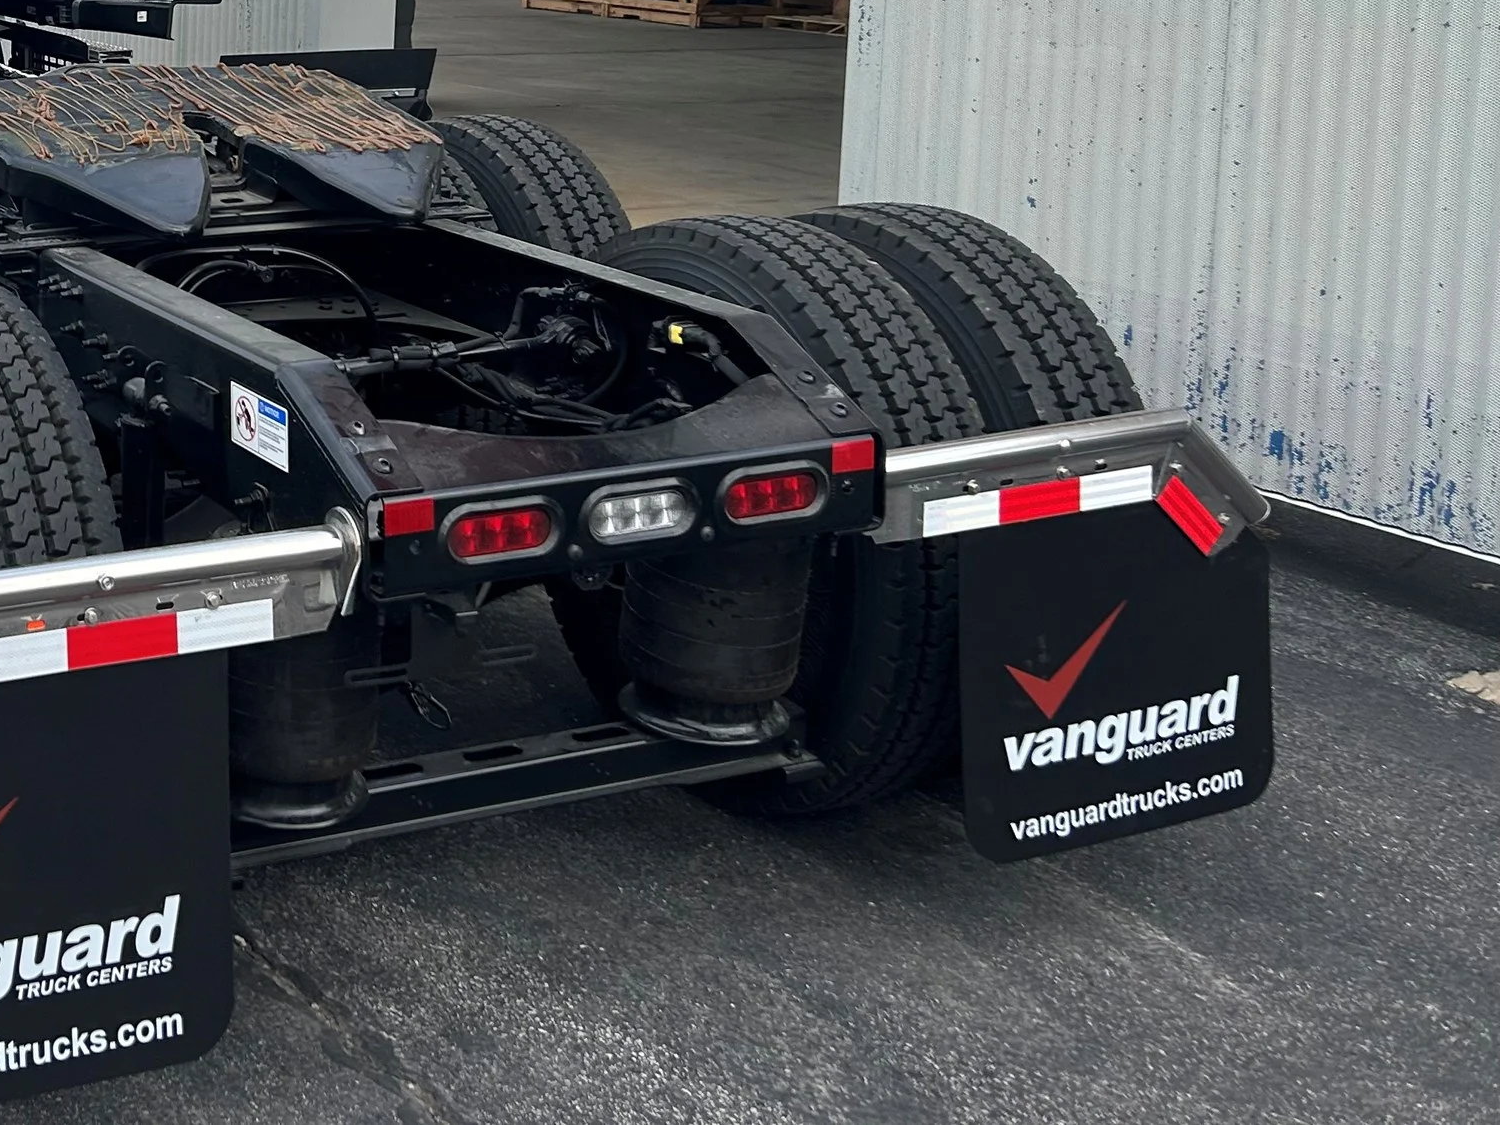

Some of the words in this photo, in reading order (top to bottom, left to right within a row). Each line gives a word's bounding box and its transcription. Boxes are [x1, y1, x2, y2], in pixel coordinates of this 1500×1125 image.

[1004, 675, 1240, 772] vanguard
[1126, 739, 1173, 761] TRUCK
[1174, 723, 1235, 750] CENTERS
[1010, 768, 1244, 840] vanguardtrucks.com
[15, 973, 82, 1001] TRUCK
[86, 956, 173, 987] CENTERS
